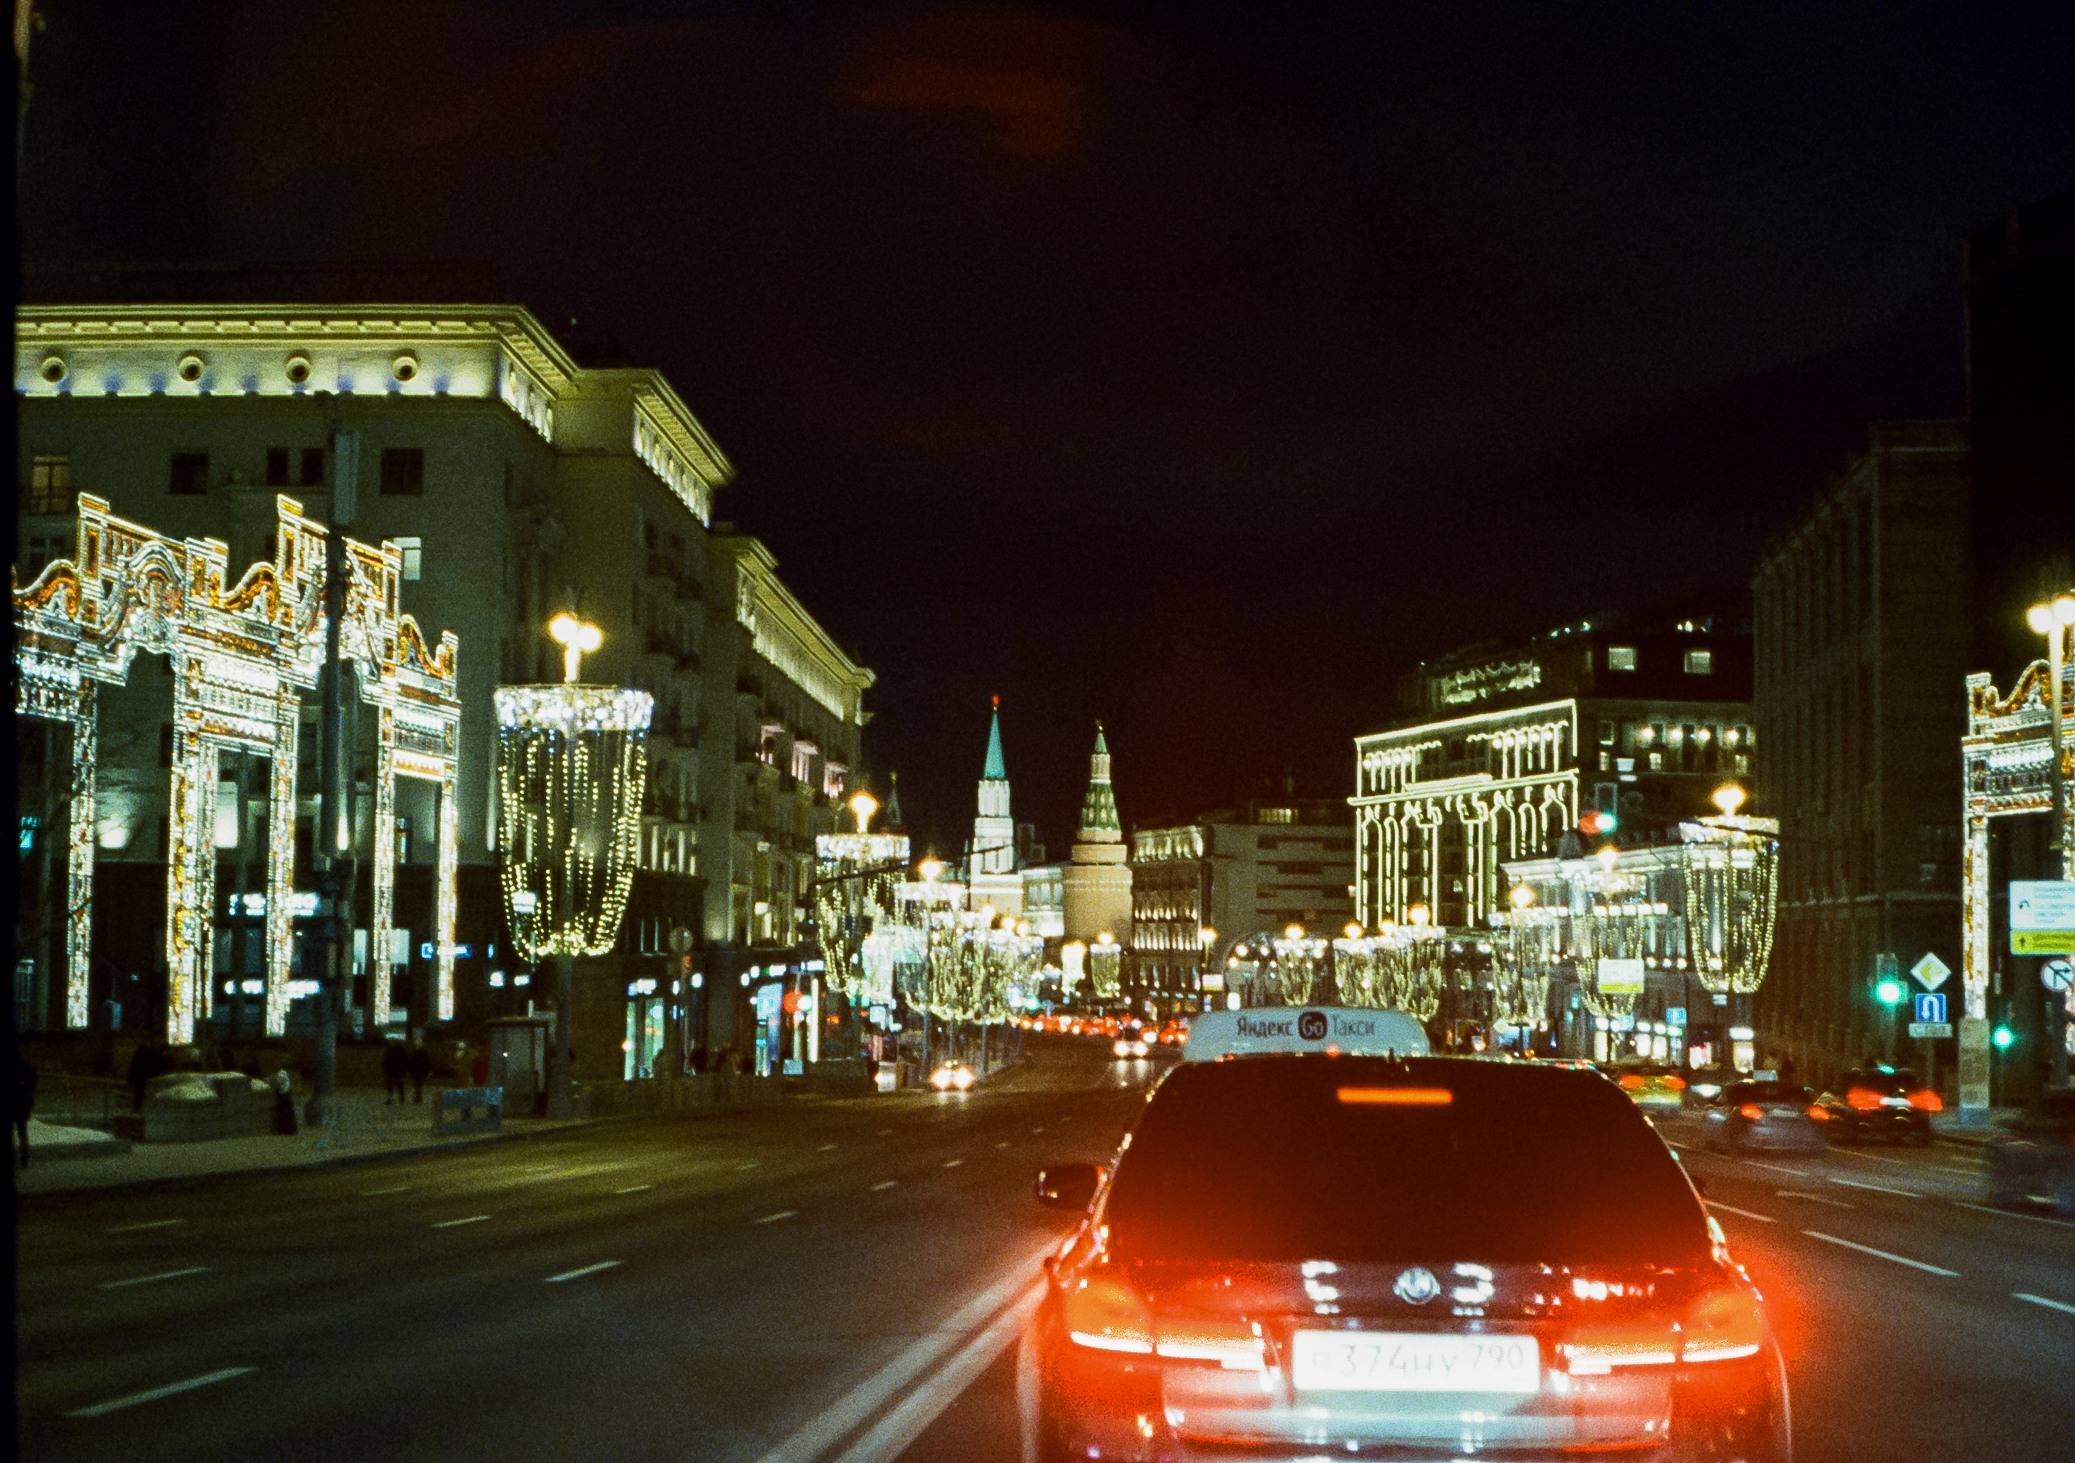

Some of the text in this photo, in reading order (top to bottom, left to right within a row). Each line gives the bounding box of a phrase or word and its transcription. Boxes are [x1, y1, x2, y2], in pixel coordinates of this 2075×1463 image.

[1237, 1014, 1375, 1039] Яндекс Go Такси
[1467, 1343, 1525, 1370] 790
